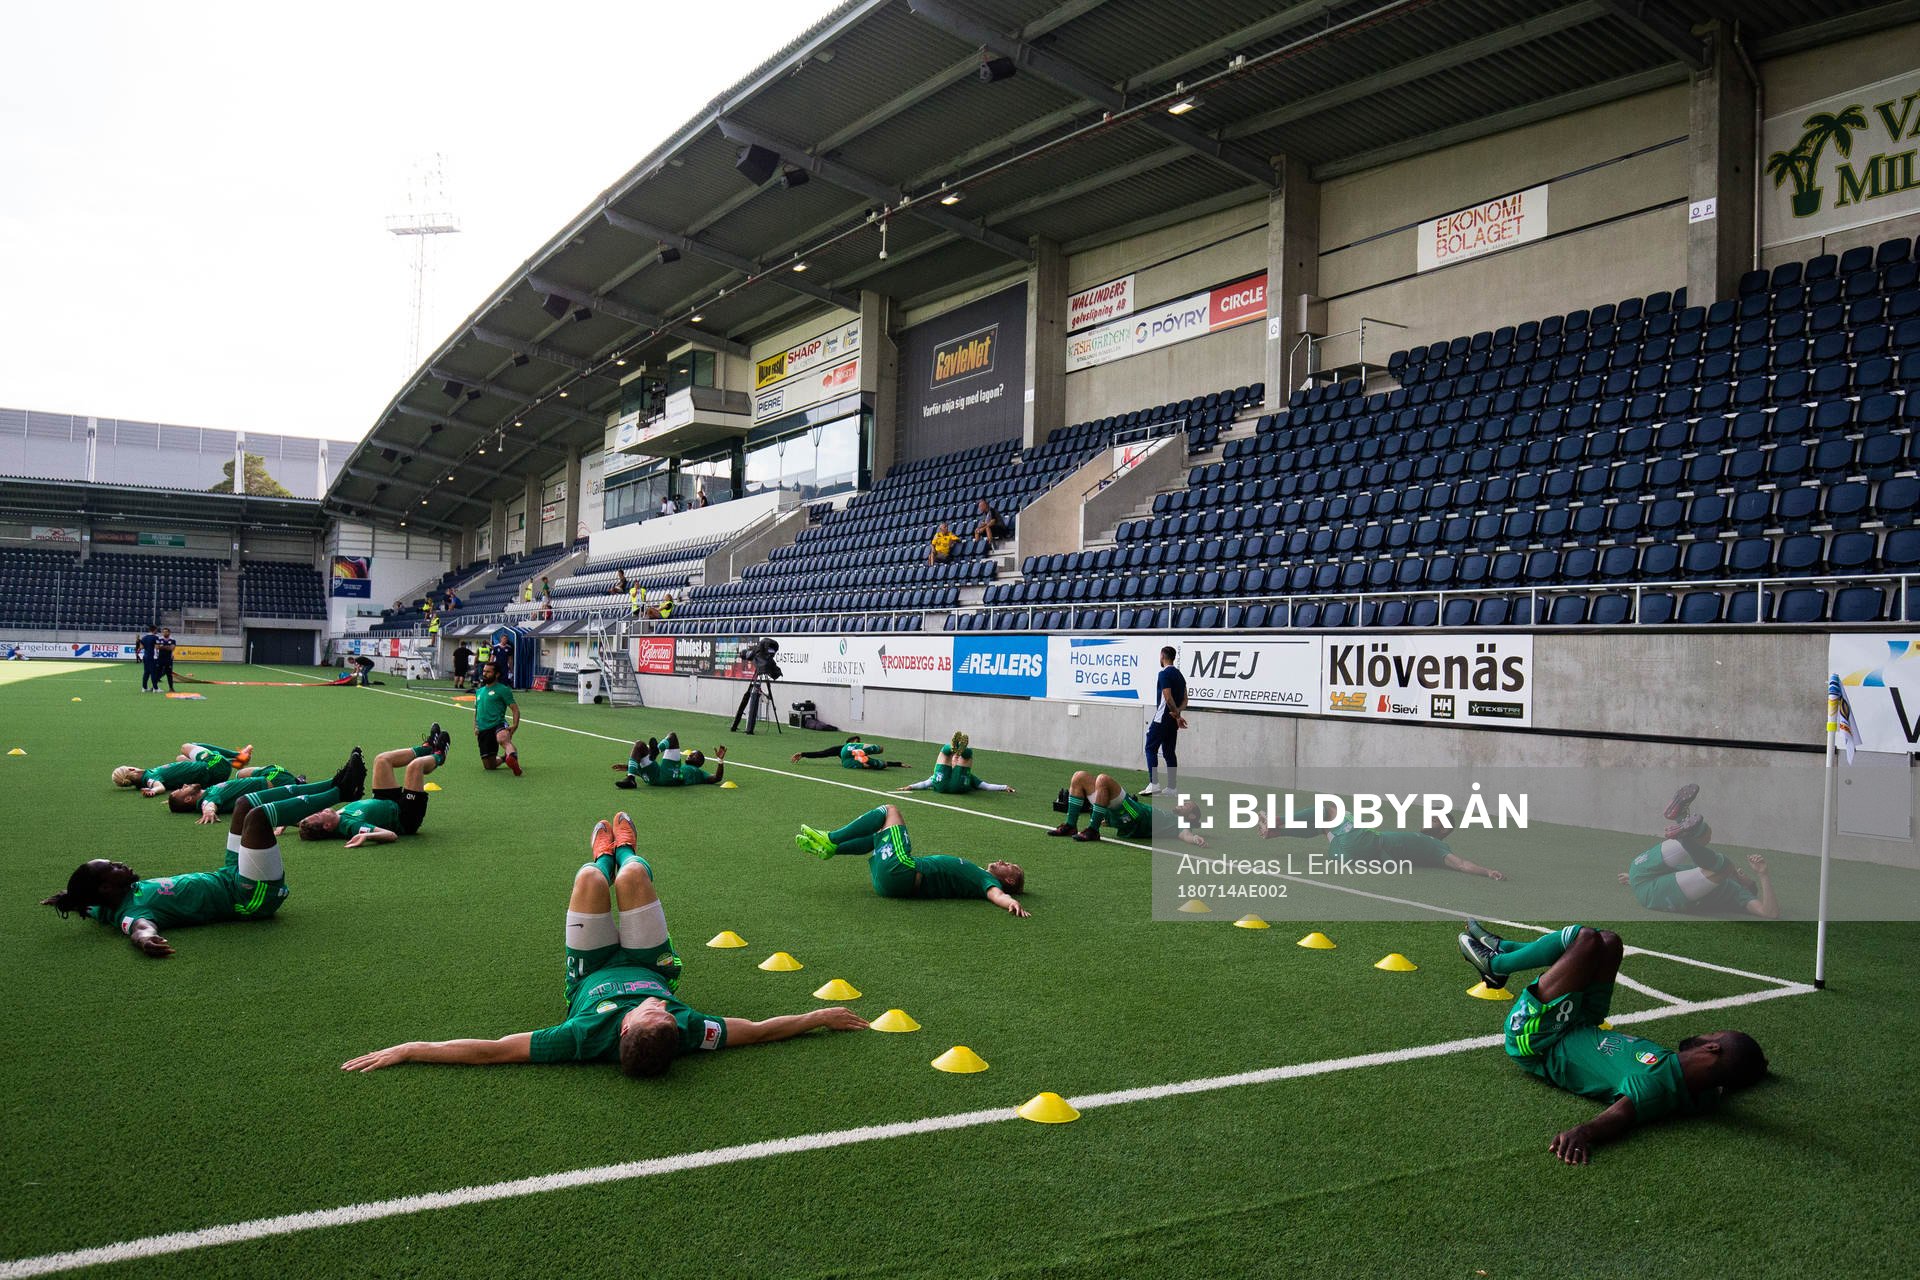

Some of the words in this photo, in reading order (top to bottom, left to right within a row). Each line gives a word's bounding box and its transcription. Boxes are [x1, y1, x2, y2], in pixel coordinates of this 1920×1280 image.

[1437, 194, 1522, 238] EKONOMI
[1436, 214, 1524, 258] BOLAGET
[1072, 280, 1127, 311] WALLINDERS
[1220, 285, 1264, 312] CIRCLE
[1071, 304, 1113, 329] golvslipning
[1116, 298, 1127, 311] AB
[1152, 306, 1208, 337] PÖYRY
[788, 340, 822, 365] SHARP
[935, 335, 992, 381] GavleNet
[758, 396, 782, 412] PIERRE
[922, 402, 941, 417] Varför
[941, 399, 955, 413] nöja
[955, 395, 965, 410] sig
[965, 389, 979, 405] med
[980, 383, 1004, 403] lagom?
[20, 642, 68, 652] Engeltofta
[775, 652, 809, 664] CASTELLUM
[1070, 651, 1139, 668] HOLMGREN
[821, 660, 866, 676] ABERSTEN
[881, 655, 934, 671] TRONDBYGG
[937, 656, 952, 671] AB
[968, 653, 1043, 678] REJLERS
[1189, 650, 1260, 680] MEJ
[1329, 643, 1525, 692] Klövenäs
[1075, 670, 1108, 685] BYGG
[1111, 672, 1131, 686] AB
[1188, 687, 1214, 698] BYGG
[1223, 689, 1303, 703] ENTREPRENAD
[1433, 698, 1452, 711] HH
[1392, 703, 1418, 715] Sievi
[1479, 705, 1521, 714] TEXSTAR
